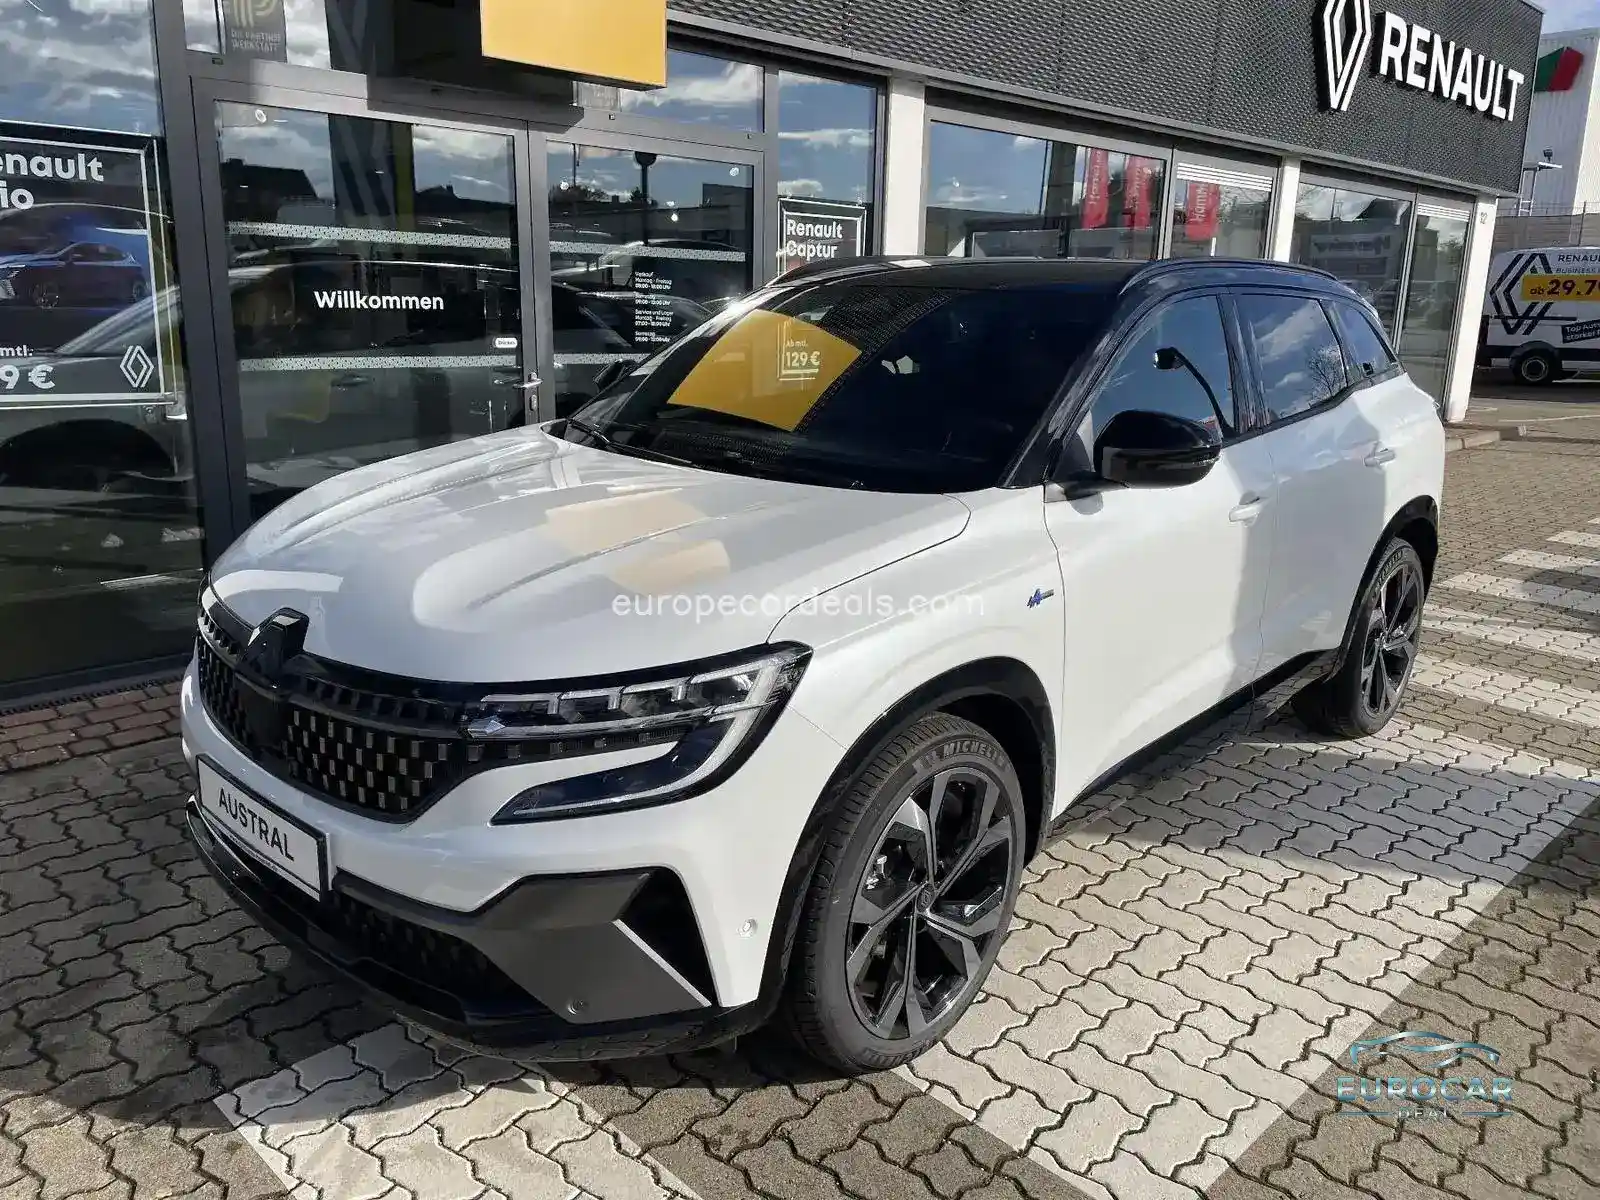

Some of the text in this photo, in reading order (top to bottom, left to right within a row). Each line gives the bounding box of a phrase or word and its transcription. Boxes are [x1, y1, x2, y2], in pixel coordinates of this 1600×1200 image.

[1380, 11, 1525, 122] RENAULT
[0, 153, 104, 182] nault
[787, 219, 843, 239] Renault
[786, 240, 838, 261] Captur
[1547, 278, 1600, 296] 29.7
[314, 290, 444, 310] Willkommen
[786, 350, 821, 367] 129 €
[0, 364, 56, 390] 9 €
[219, 787, 295, 862] AUSTRAL
